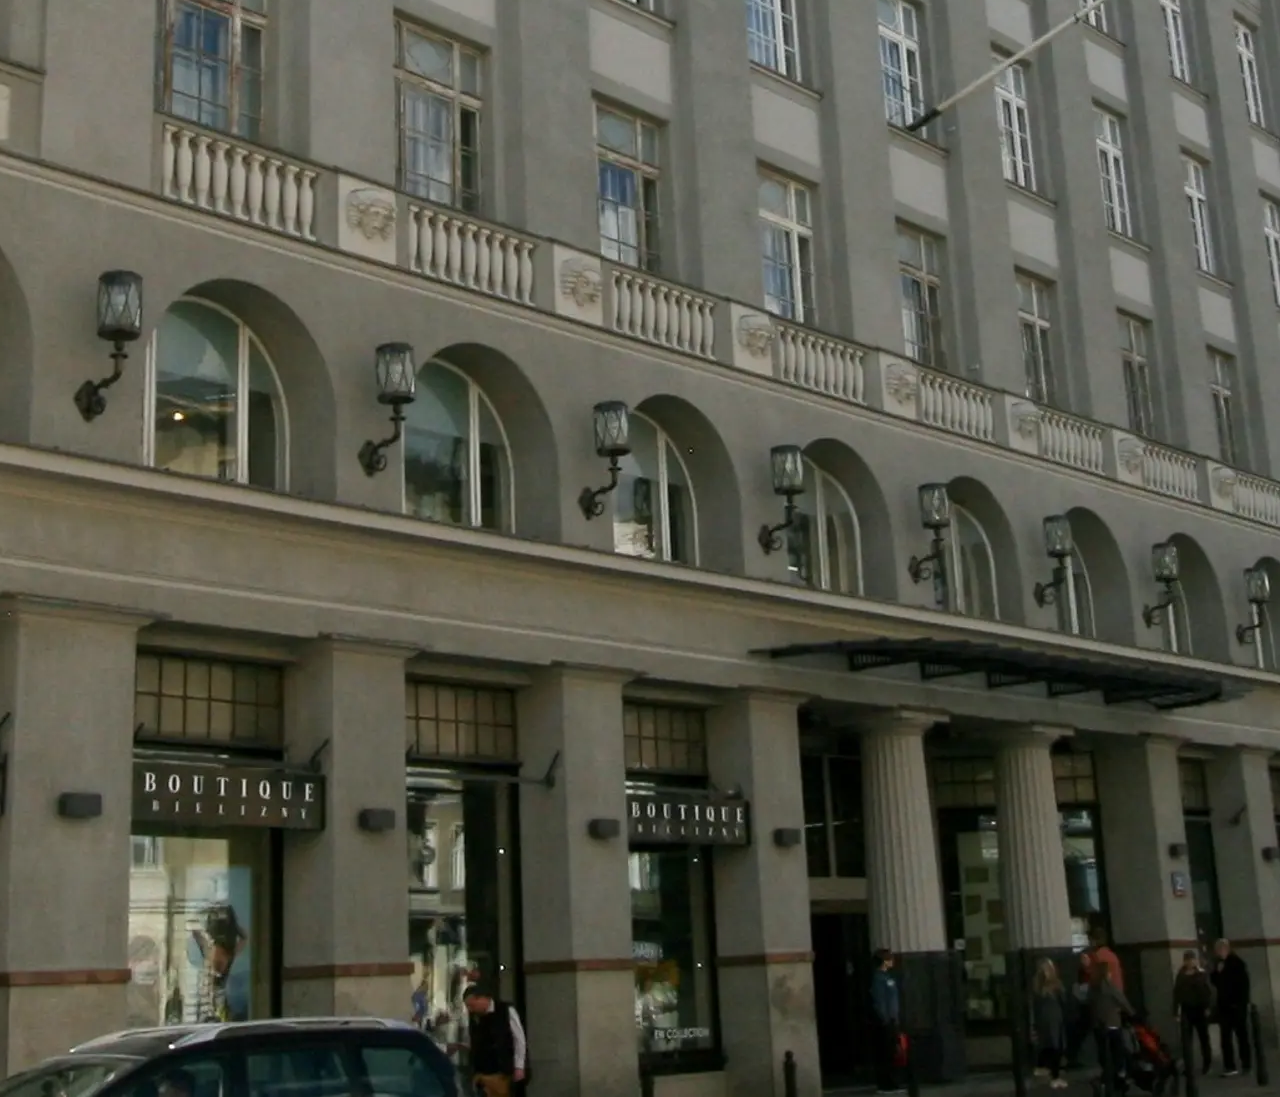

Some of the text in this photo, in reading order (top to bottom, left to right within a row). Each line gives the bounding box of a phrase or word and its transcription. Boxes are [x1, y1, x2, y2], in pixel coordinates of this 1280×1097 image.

[144, 772, 315, 802] BOUTIQUE
[151, 799, 308, 820] BIELIZNY
[631, 801, 745, 823] BOUTIQUE
